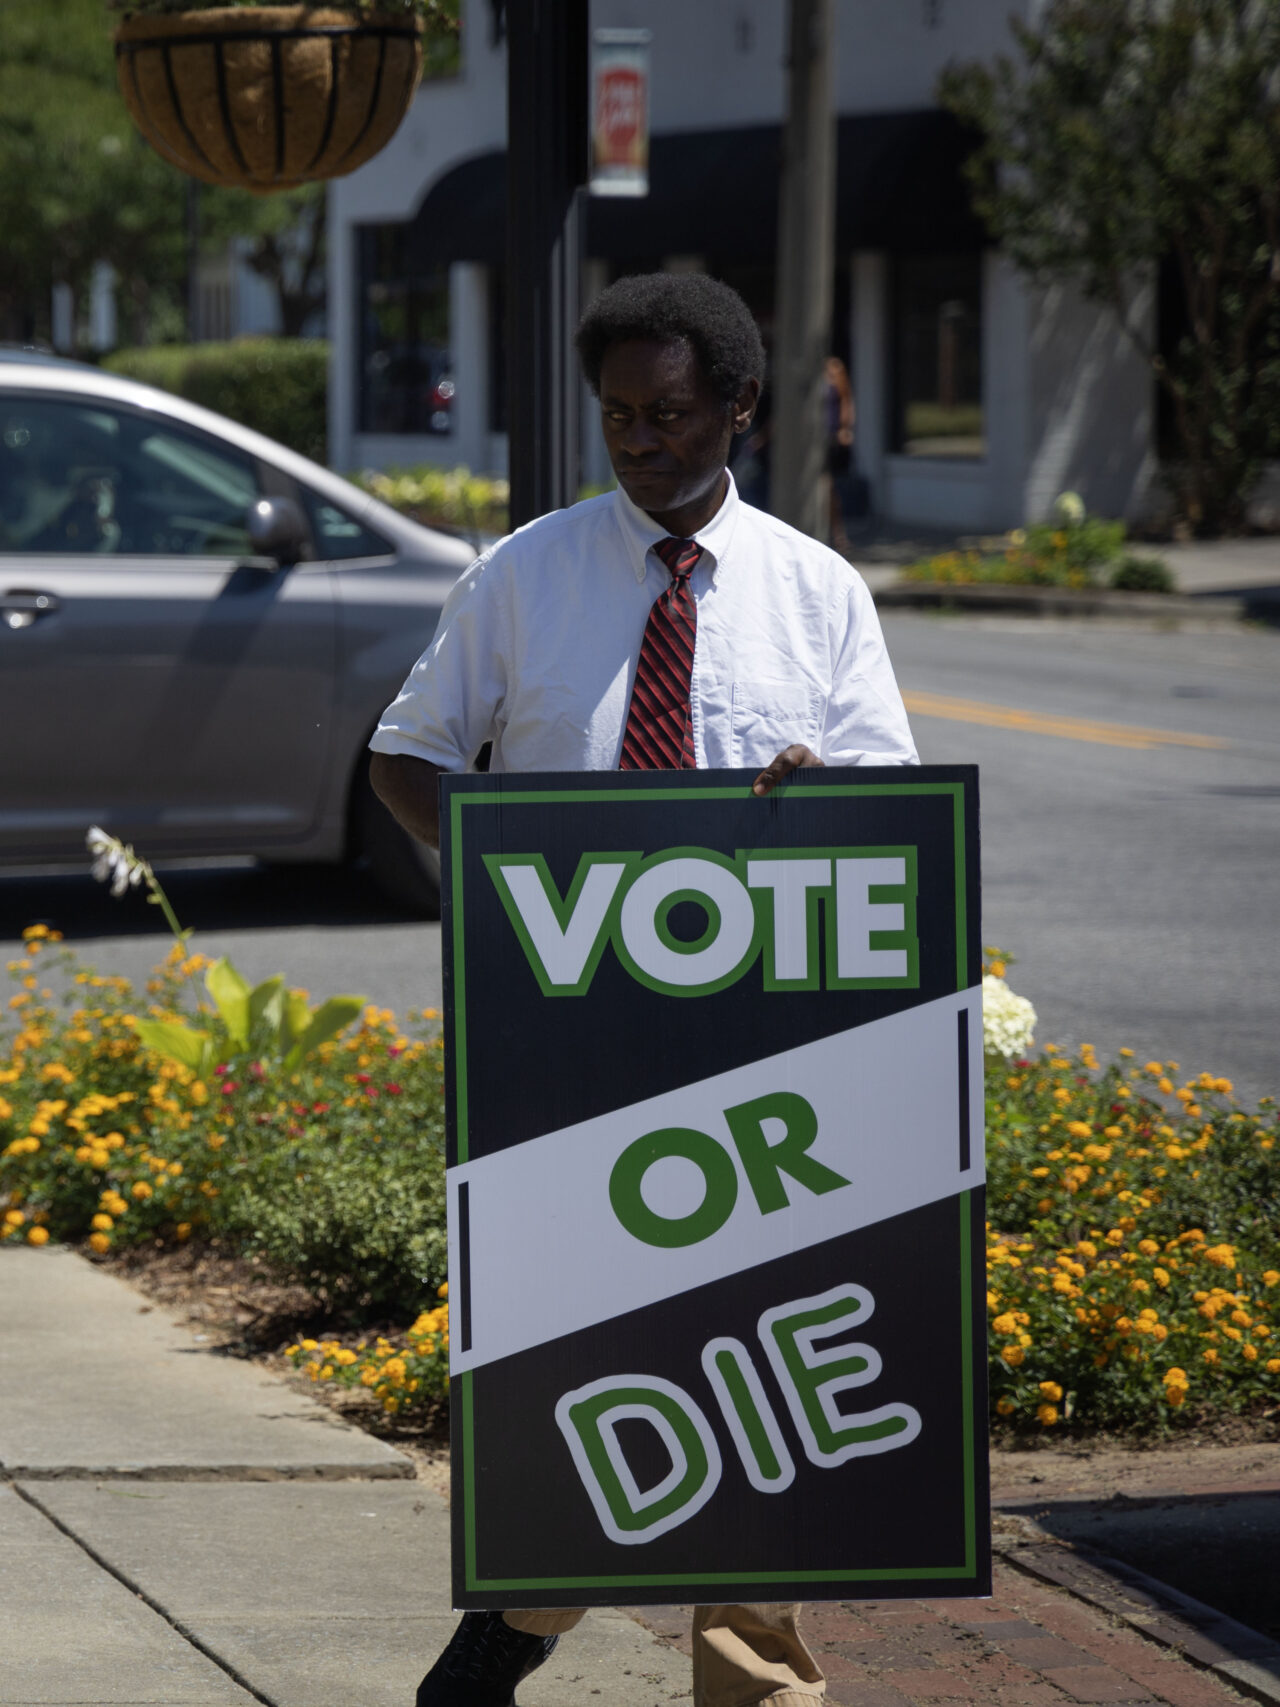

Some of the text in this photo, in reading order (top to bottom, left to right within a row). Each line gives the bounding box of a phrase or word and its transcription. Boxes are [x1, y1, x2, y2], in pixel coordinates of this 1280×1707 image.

[481, 845, 920, 998] VOTE
[608, 1090, 853, 1249] OR
[554, 1282, 922, 1545] DIE
